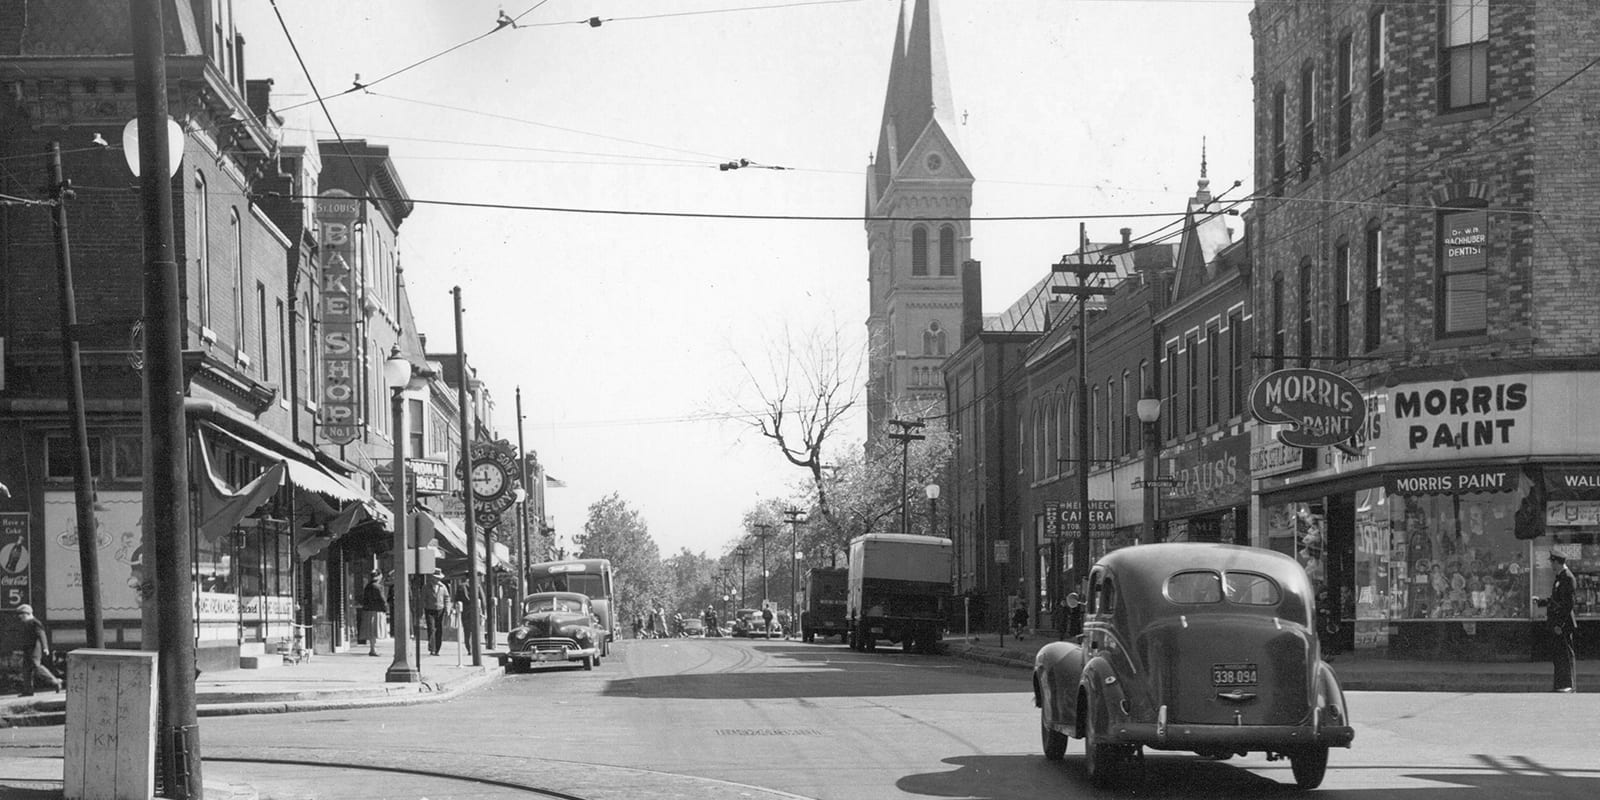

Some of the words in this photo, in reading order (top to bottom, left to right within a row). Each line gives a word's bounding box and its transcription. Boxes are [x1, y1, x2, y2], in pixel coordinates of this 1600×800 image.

[329, 203, 356, 212] LOUIS
[1448, 247, 1481, 257] DENTIST
[324, 222, 350, 314] BAKE
[324, 331, 352, 423] SHOP
[1265, 375, 1354, 413] MORRIS
[1395, 382, 1528, 419] MORRIS
[1303, 416, 1352, 437] PAINT
[1409, 418, 1515, 450] PAINT
[496, 452, 518, 476] SONS
[1397, 476, 1452, 491] MORRIS
[1458, 473, 1506, 488] PAINT
[1061, 511, 1114, 521] CAERA
[1065, 501, 1110, 510] MEMEC
